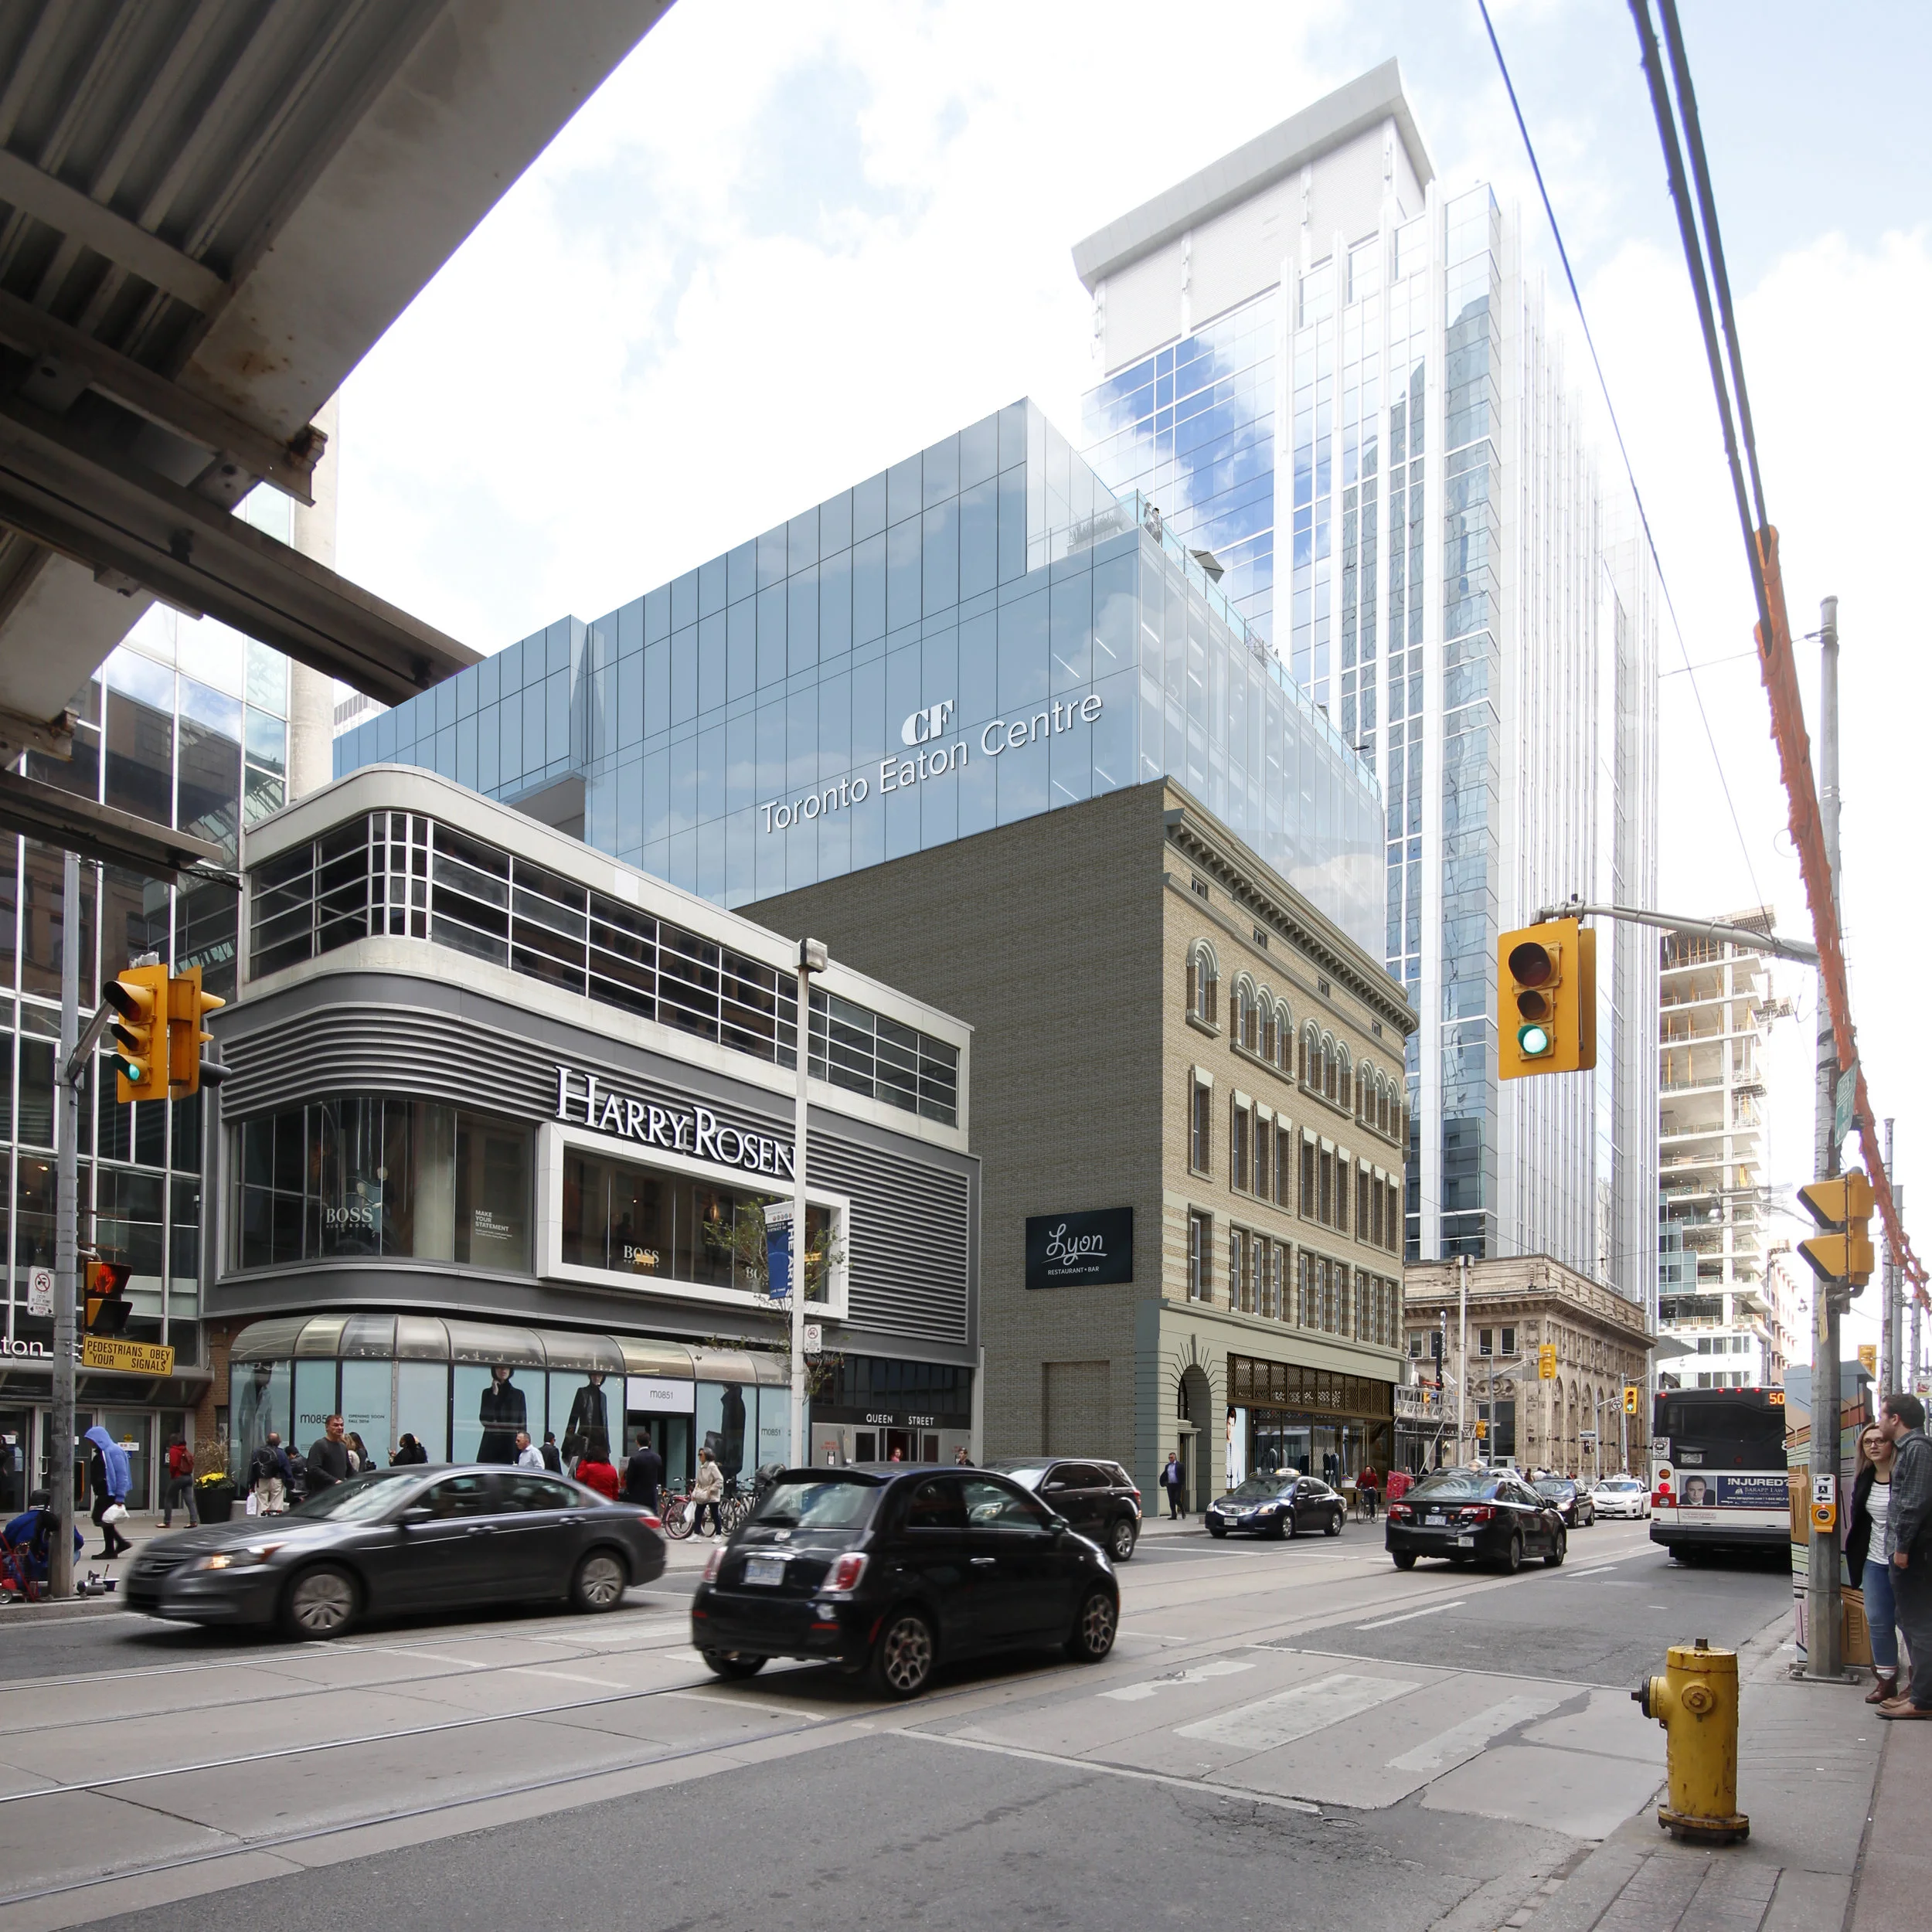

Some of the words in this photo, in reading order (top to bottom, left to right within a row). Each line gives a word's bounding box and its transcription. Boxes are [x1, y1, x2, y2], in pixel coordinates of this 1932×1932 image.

[901, 699, 954, 746] CF
[761, 777, 869, 833] Toronto
[879, 742, 968, 794] Eaton
[981, 694, 1103, 757] Centre
[555, 1066, 690, 1150] HARRY
[692, 1106, 795, 1179] ROSEN
[326, 1206, 373, 1223] BOSS
[475, 1221, 509, 1232] STATEMENT
[1046, 1223, 1103, 1266] Lyon
[624, 1245, 660, 1264] BOSS
[87, 1341, 143, 1358] PEDESTRIANS
[150, 1349, 171, 1361] OBEY
[93, 1353, 114, 1366] YOUR
[131, 1358, 165, 1372] SIGNALS
[650, 1389, 673, 1400] m0851
[300, 1414, 327, 1424] m085
[866, 1413, 893, 1423] QUEEN
[908, 1416, 934, 1426] STREET
[761, 1428, 781, 1437] m0851
